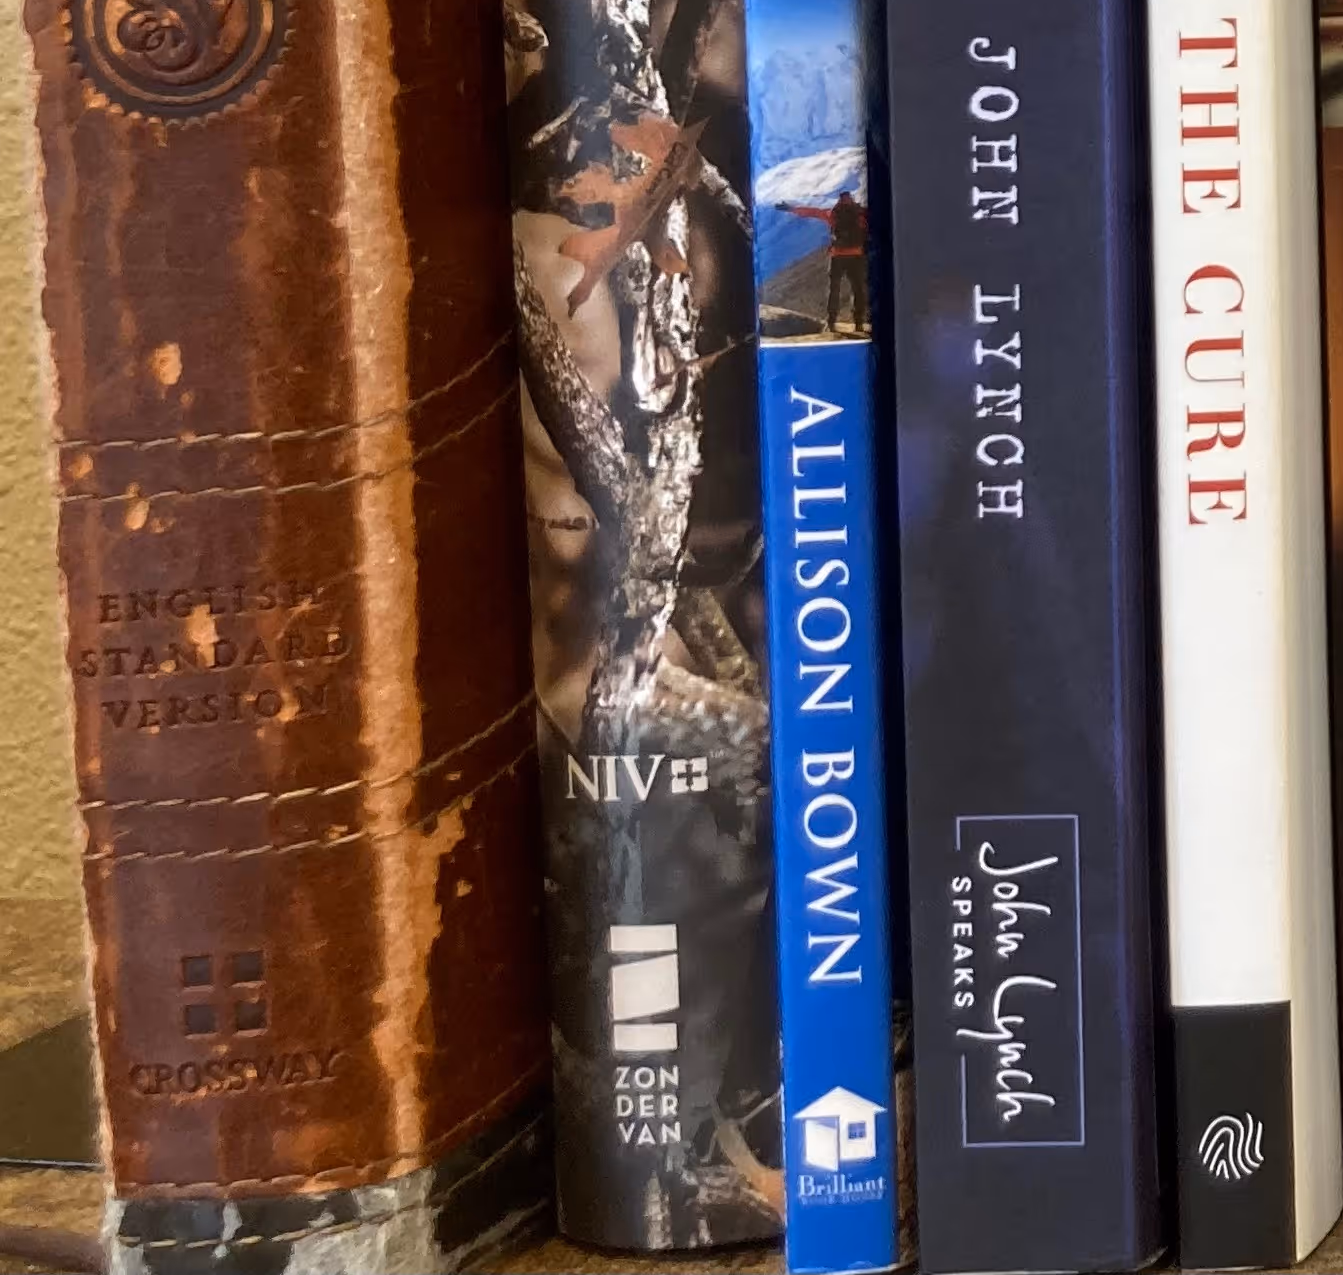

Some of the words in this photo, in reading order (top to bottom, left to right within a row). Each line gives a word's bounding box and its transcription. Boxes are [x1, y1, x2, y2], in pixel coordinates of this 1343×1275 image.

[968, 36, 1019, 224] JOHN
[1177, 17, 1246, 215] THE
[972, 284, 1025, 520] LYNCH
[1181, 263, 1246, 527] CURE
[791, 386, 854, 715] ALLISON
[97, 580, 324, 624] ENGLISH
[76, 633, 350, 678] STANDARD
[100, 684, 330, 730] VERSION
[565, 754, 666, 802] NIV
[801, 750, 863, 985] BOWN
[979, 841, 1058, 960] John
[950, 876, 974, 1011] SPEAKS
[129, 1047, 342, 1096] CROSSWAY
[616, 1065, 678, 1088] ZON
[956, 974, 1056, 1122] Lynch
[616, 1094, 677, 1117] DER
[618, 1121, 681, 1144] VAN
[799, 1174, 886, 1196] Brilliant
